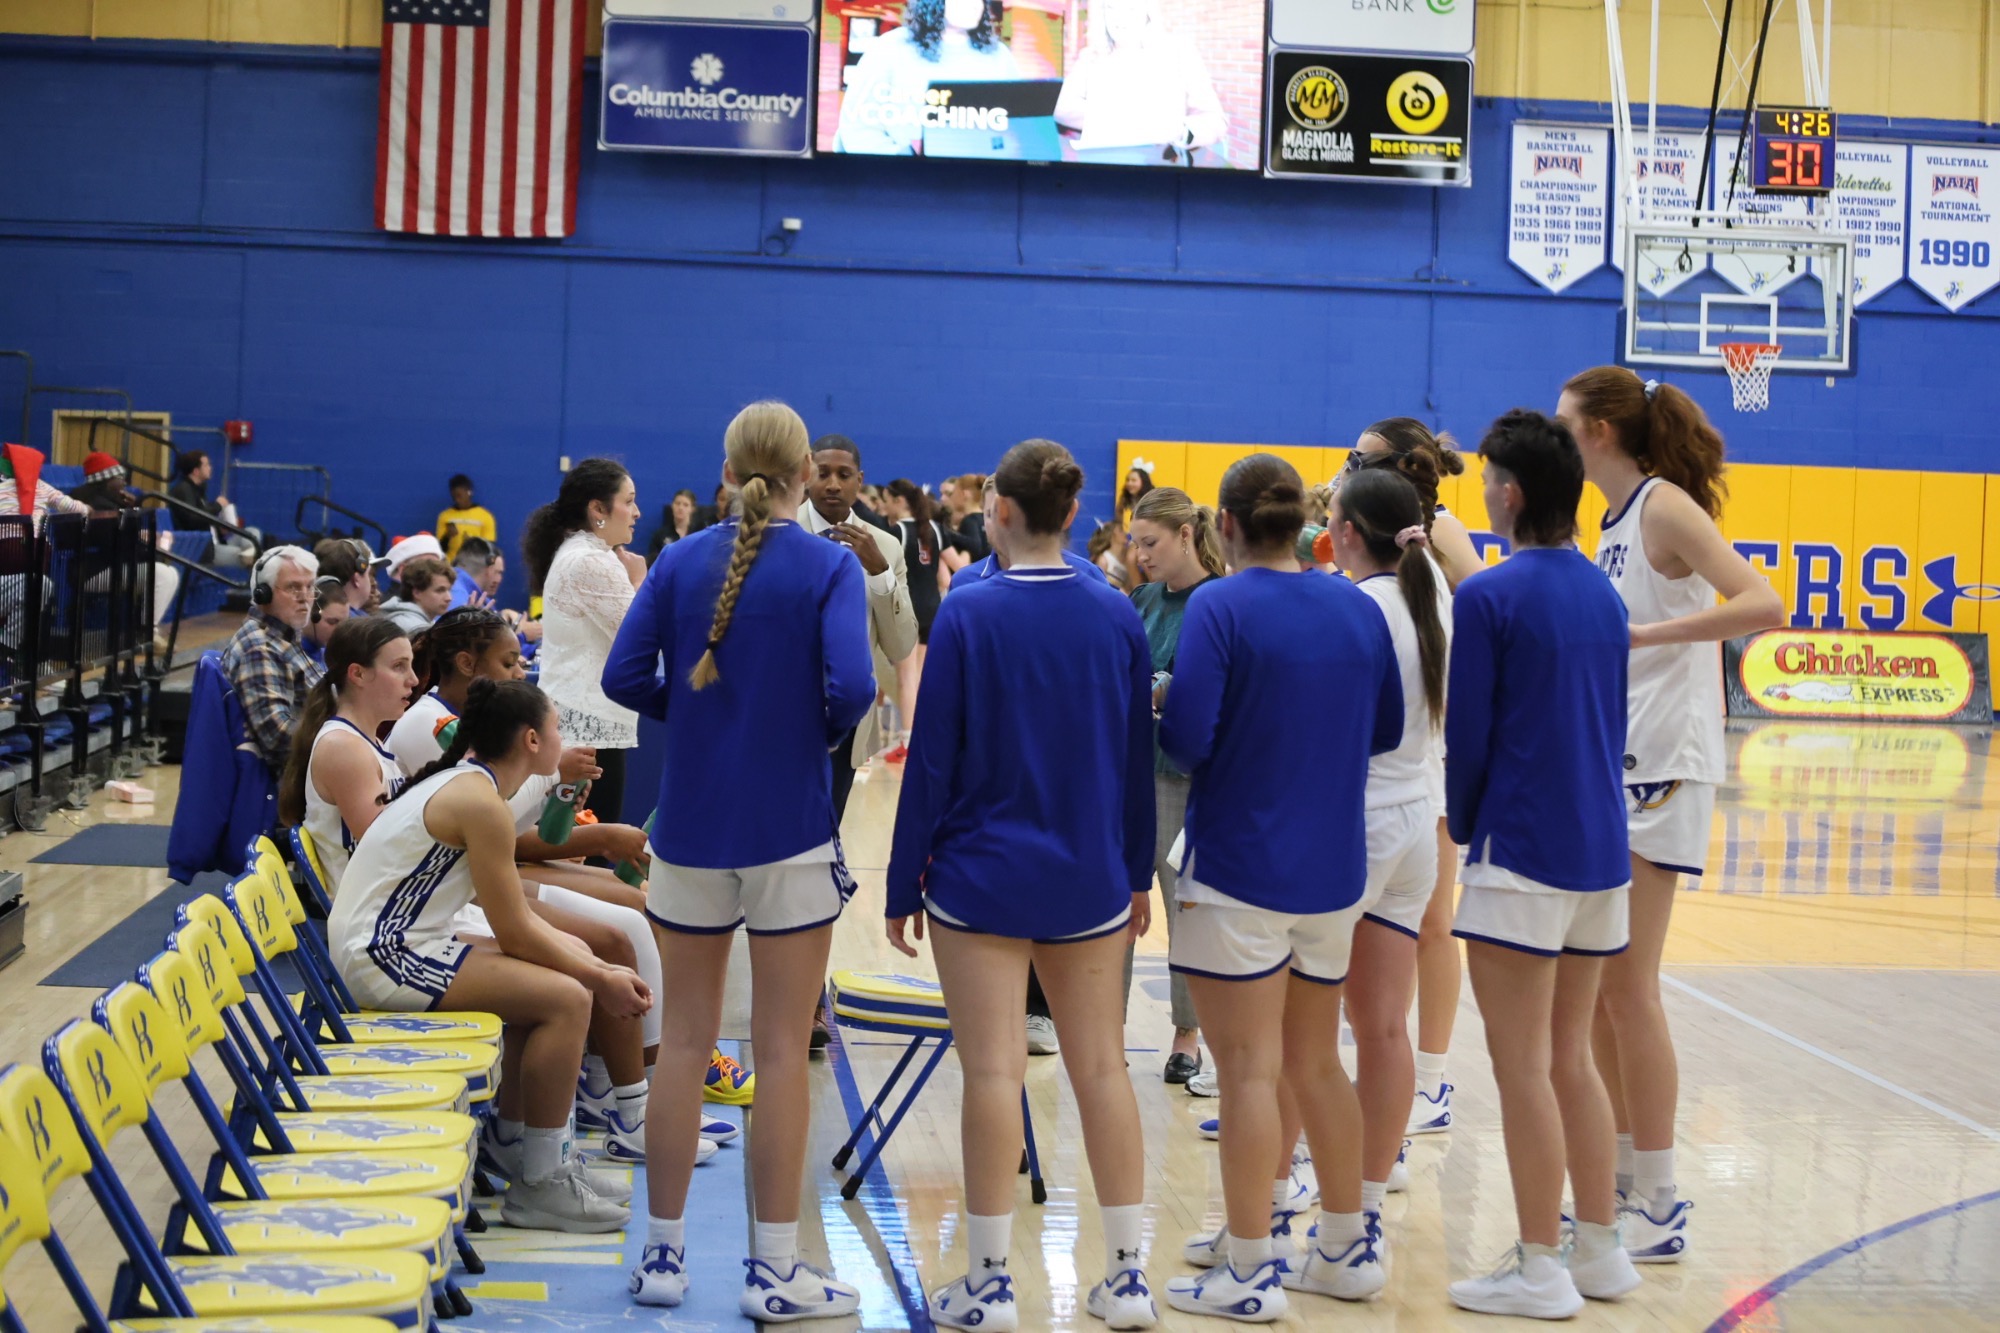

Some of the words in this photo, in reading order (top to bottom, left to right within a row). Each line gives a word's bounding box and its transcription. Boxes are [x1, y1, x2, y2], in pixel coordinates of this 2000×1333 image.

[1352, 0, 1414, 12] BANK
[634, 106, 720, 121] AMBULANCE
[725, 110, 780, 123] SERVICE
[861, 101, 1008, 131] COACHING
[1776, 112, 1830, 136] 4:26
[1282, 129, 1354, 150] MAGNOLIA
[1545, 130, 1577, 142] MEN'S
[1653, 137, 1679, 146] EN'S
[1527, 141, 1593, 153] BASKETBALL
[1282, 147, 1311, 160] GLASS
[1311, 149, 1319, 161] &
[1320, 150, 1354, 163] MIRROR
[1836, 152, 1892, 163] OLLEYBALL
[1537, 155, 1580, 175] NAIA
[1768, 142, 1820, 185] 30
[1926, 156, 1989, 168] VOLLEYBALL
[1520, 180, 1597, 192] CHAMPIONSHIP
[1934, 175, 1976, 194] NAIA
[1535, 192, 1581, 203] SEASONS
[1514, 203, 1540, 214] 1934
[1544, 205, 1571, 216] 1957
[1930, 200, 1981, 212] NATIONAL
[1514, 217, 1540, 228] 1935
[1920, 210, 1991, 223] TOURNAMENT
[1875, 221, 1901, 232] 1990
[1574, 234, 1601, 245] 1990
[1875, 235, 1900, 245] 1994
[1544, 247, 1569, 257] 1971
[1919, 238, 1990, 268] 1990
[1774, 641, 1940, 679] Chicken
[1860, 685, 1944, 703] EXPRESS
